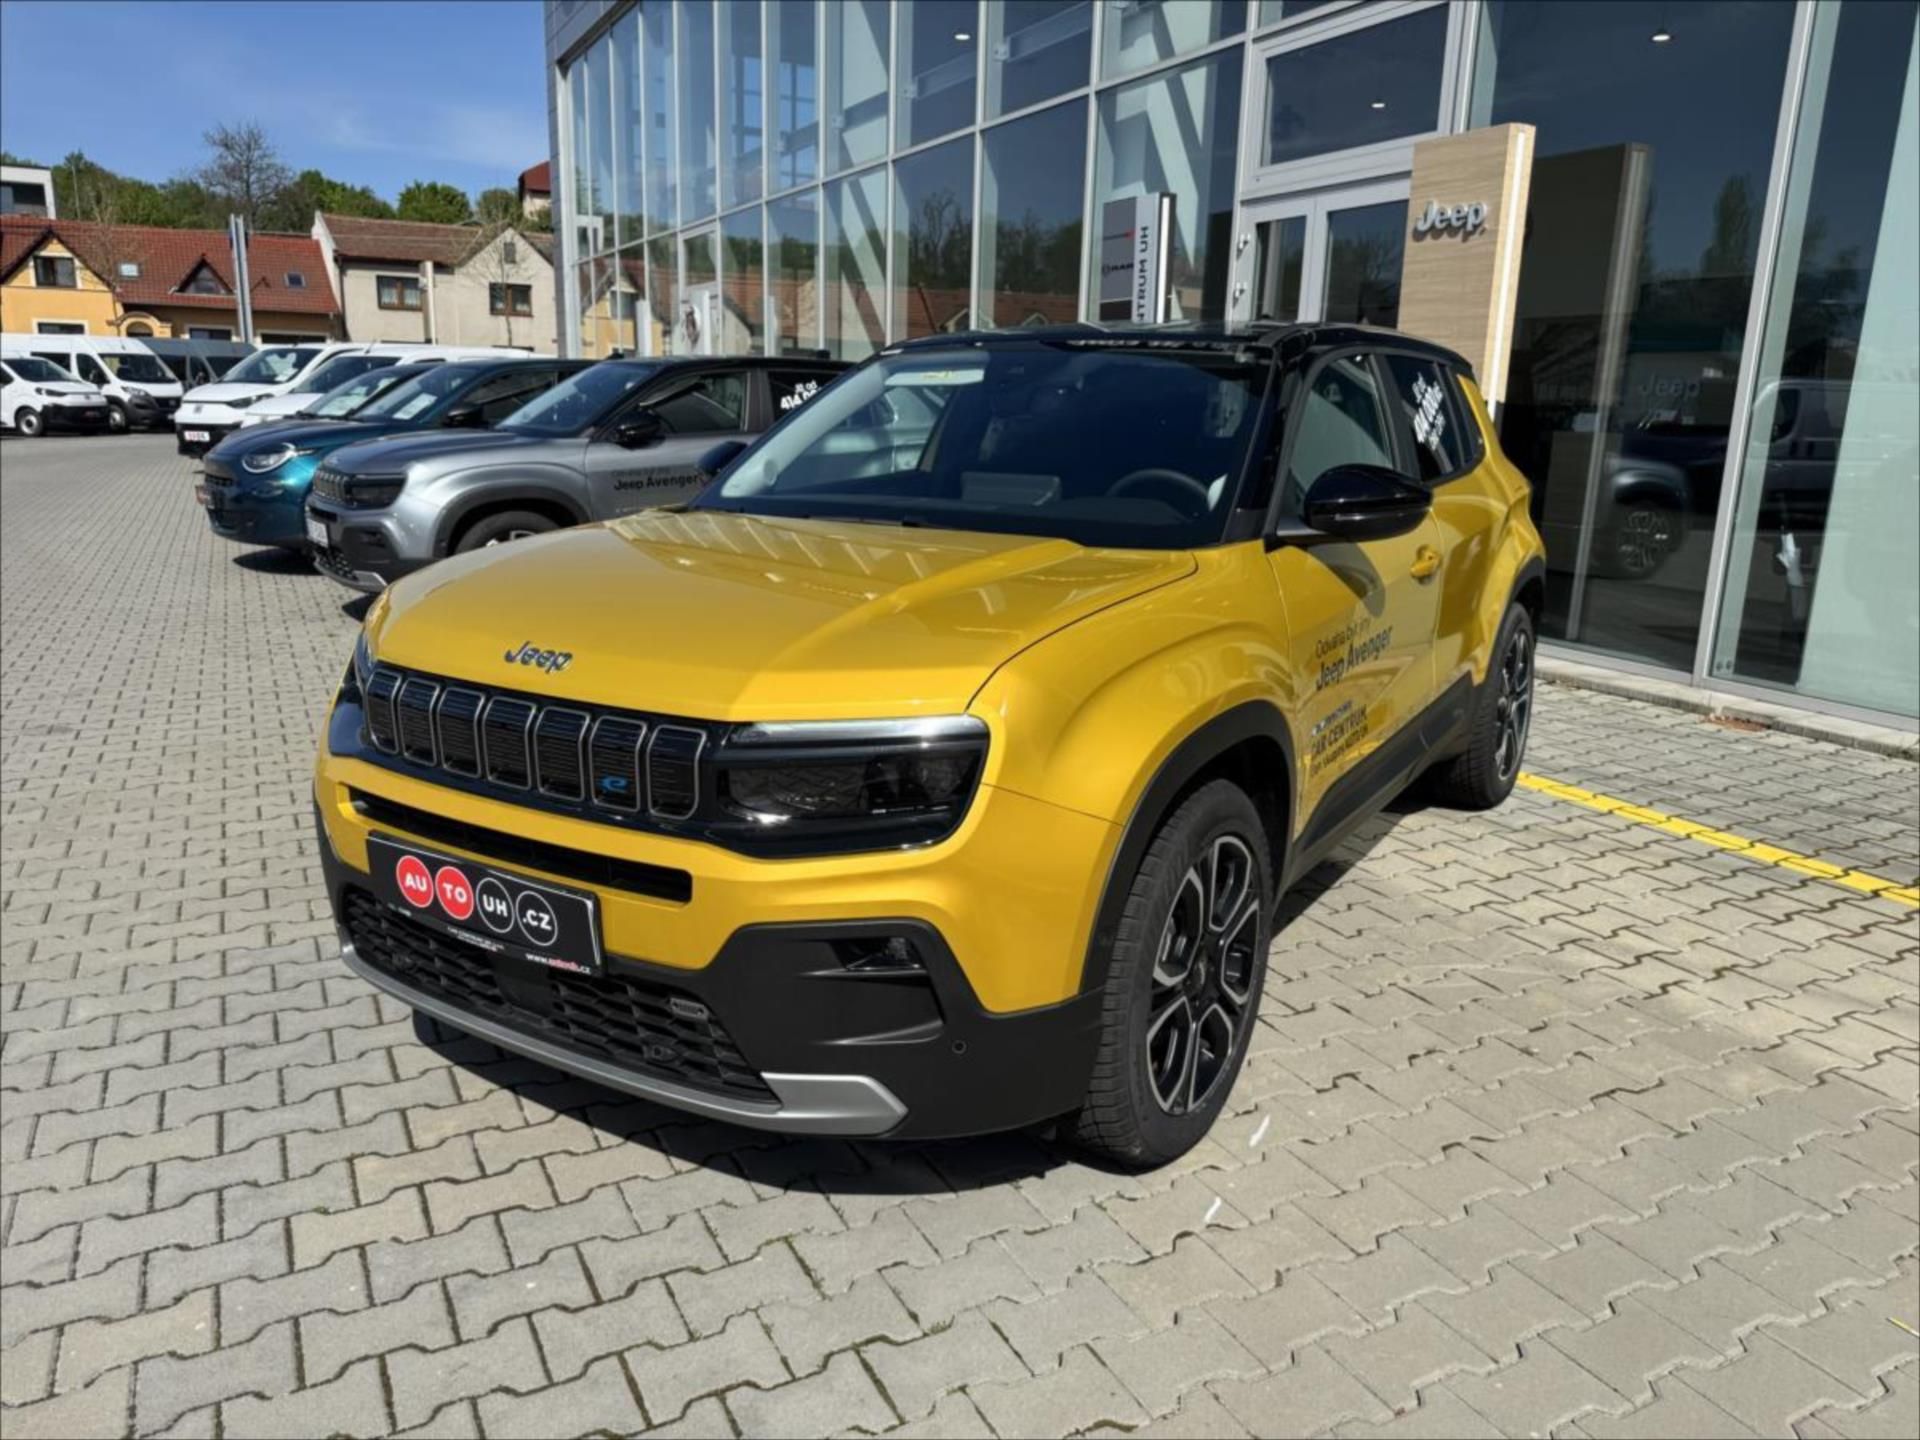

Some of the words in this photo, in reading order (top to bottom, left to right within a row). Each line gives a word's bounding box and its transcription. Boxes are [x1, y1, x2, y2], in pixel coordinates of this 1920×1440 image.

[1415, 200, 1488, 236] Jeep
[1139, 225, 1150, 253] UH
[614, 479, 644, 491] Jeep
[646, 473, 698, 489] Avenger
[503, 640, 573, 675] Jeep
[1316, 657, 1345, 692] Jeep
[1346, 626, 1393, 672] Avenger
[404, 872, 428, 892] AU
[443, 883, 468, 903] TO
[483, 893, 508, 917] UH
